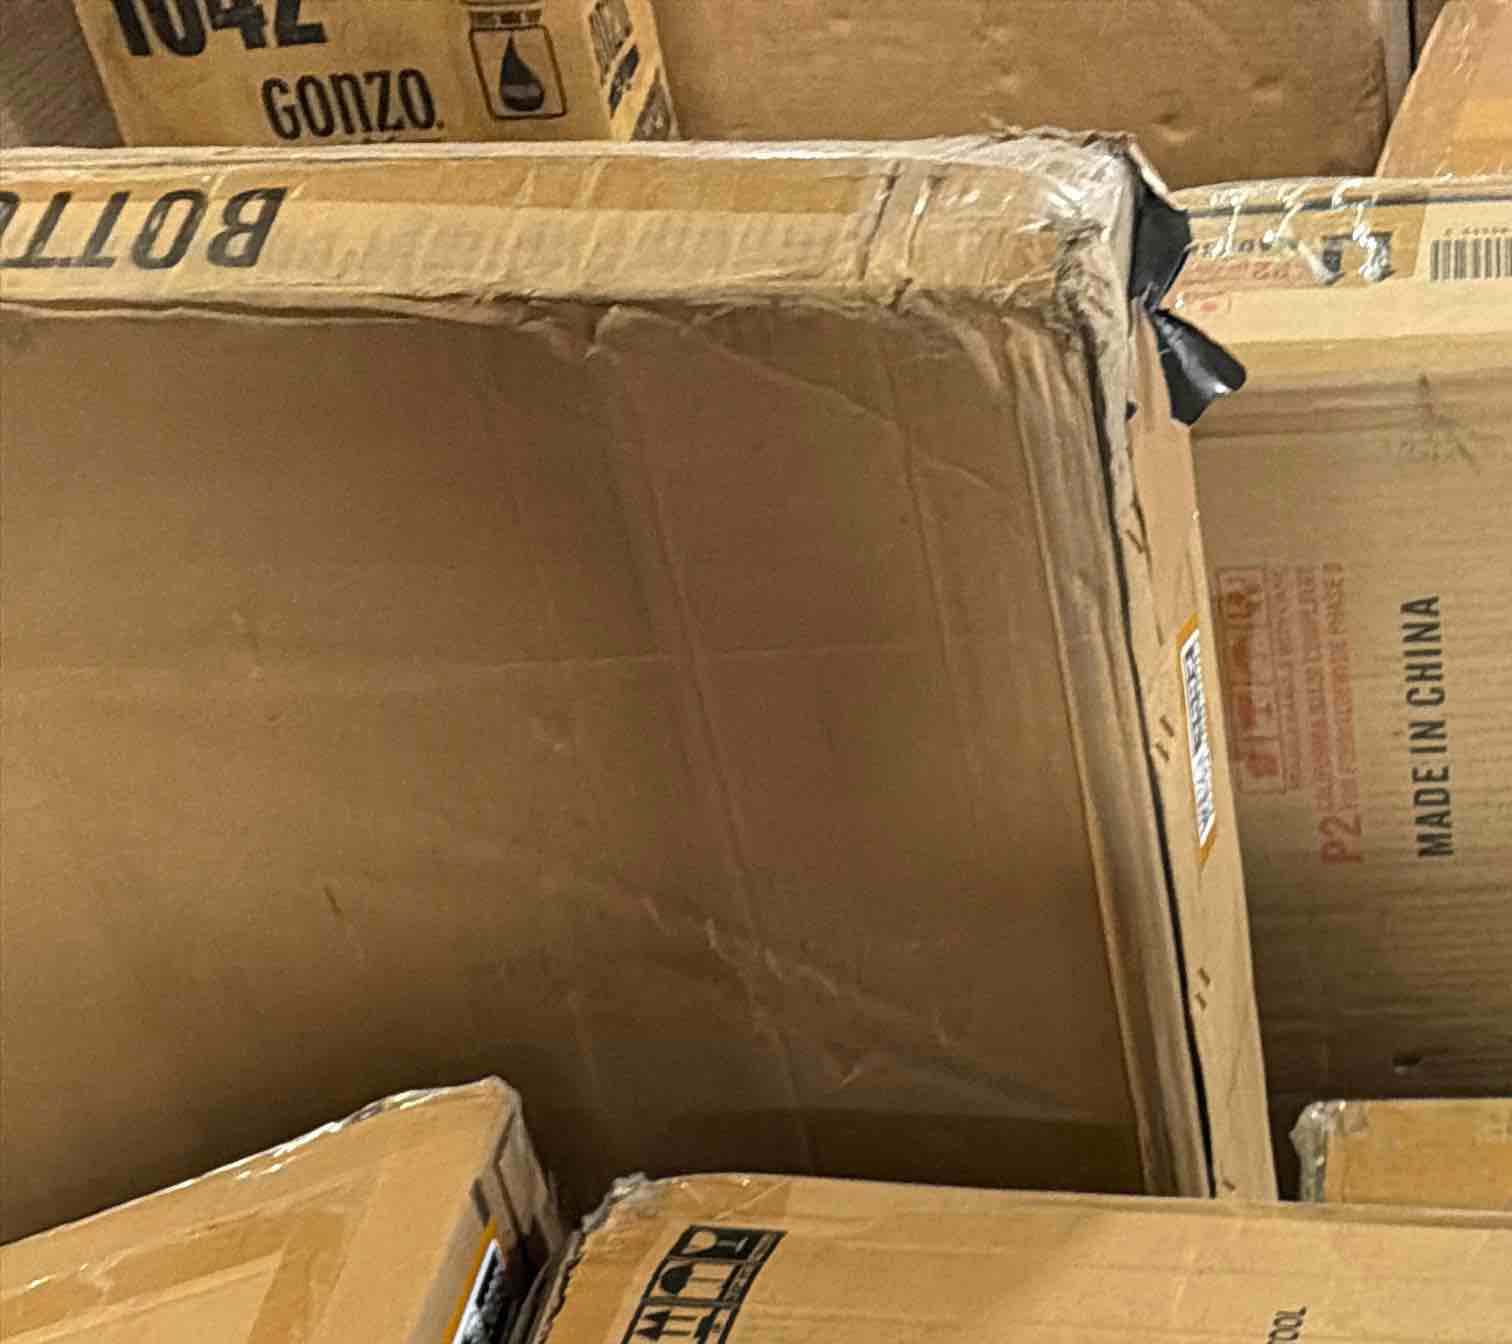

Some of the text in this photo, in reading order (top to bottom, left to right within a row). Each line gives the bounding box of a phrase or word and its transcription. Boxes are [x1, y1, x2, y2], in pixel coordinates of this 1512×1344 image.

[0, 186, 288, 270] BOTT
[1401, 595, 1454, 858] MADE IN CHINA
